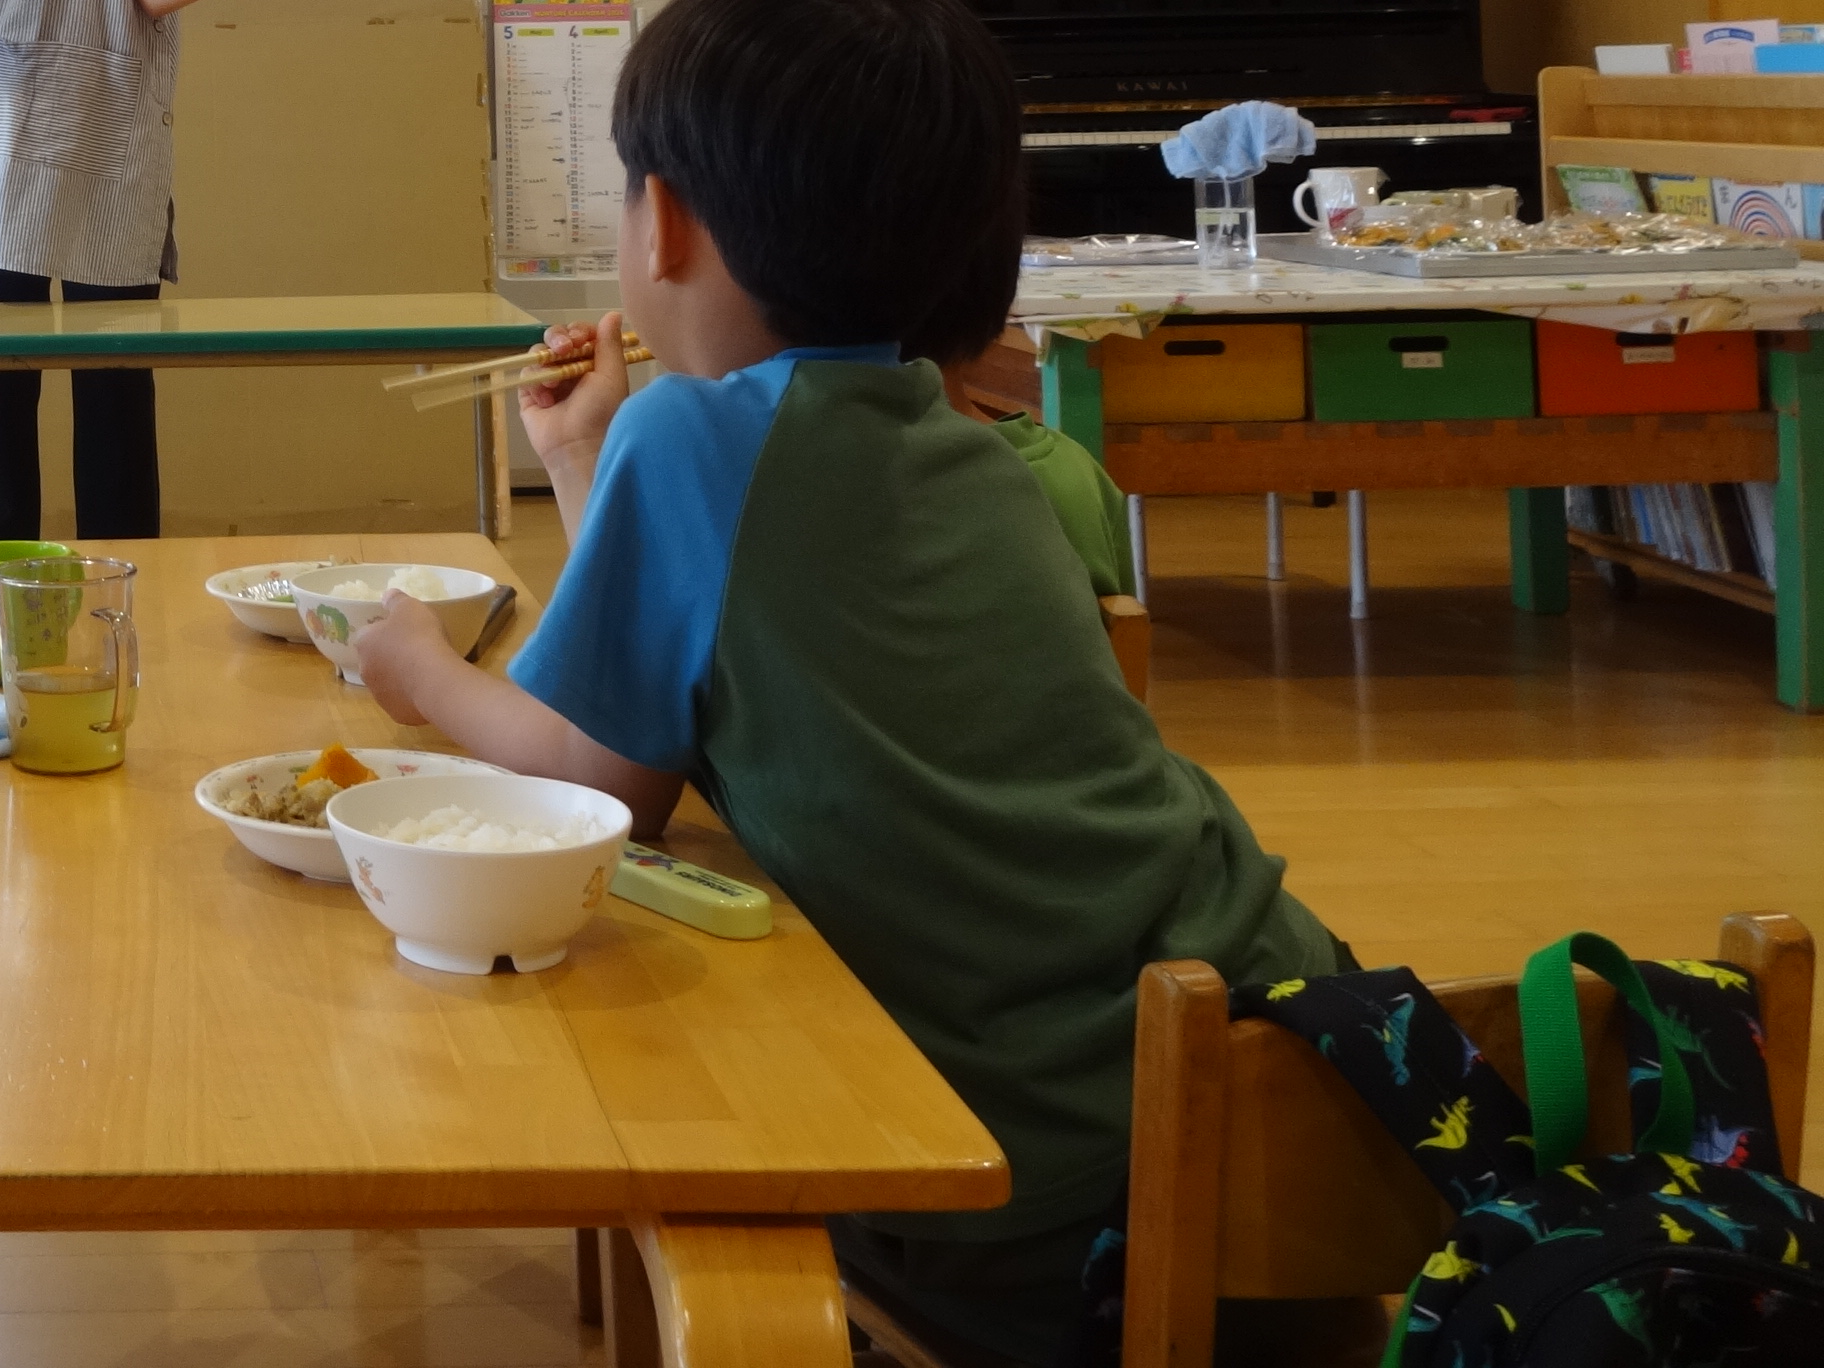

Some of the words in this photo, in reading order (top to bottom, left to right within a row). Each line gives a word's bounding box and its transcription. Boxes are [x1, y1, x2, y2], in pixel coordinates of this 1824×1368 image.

[504, 26, 514, 40] 5
[568, 25, 579, 39] 4
[1116, 80, 1188, 92] KAWAI
